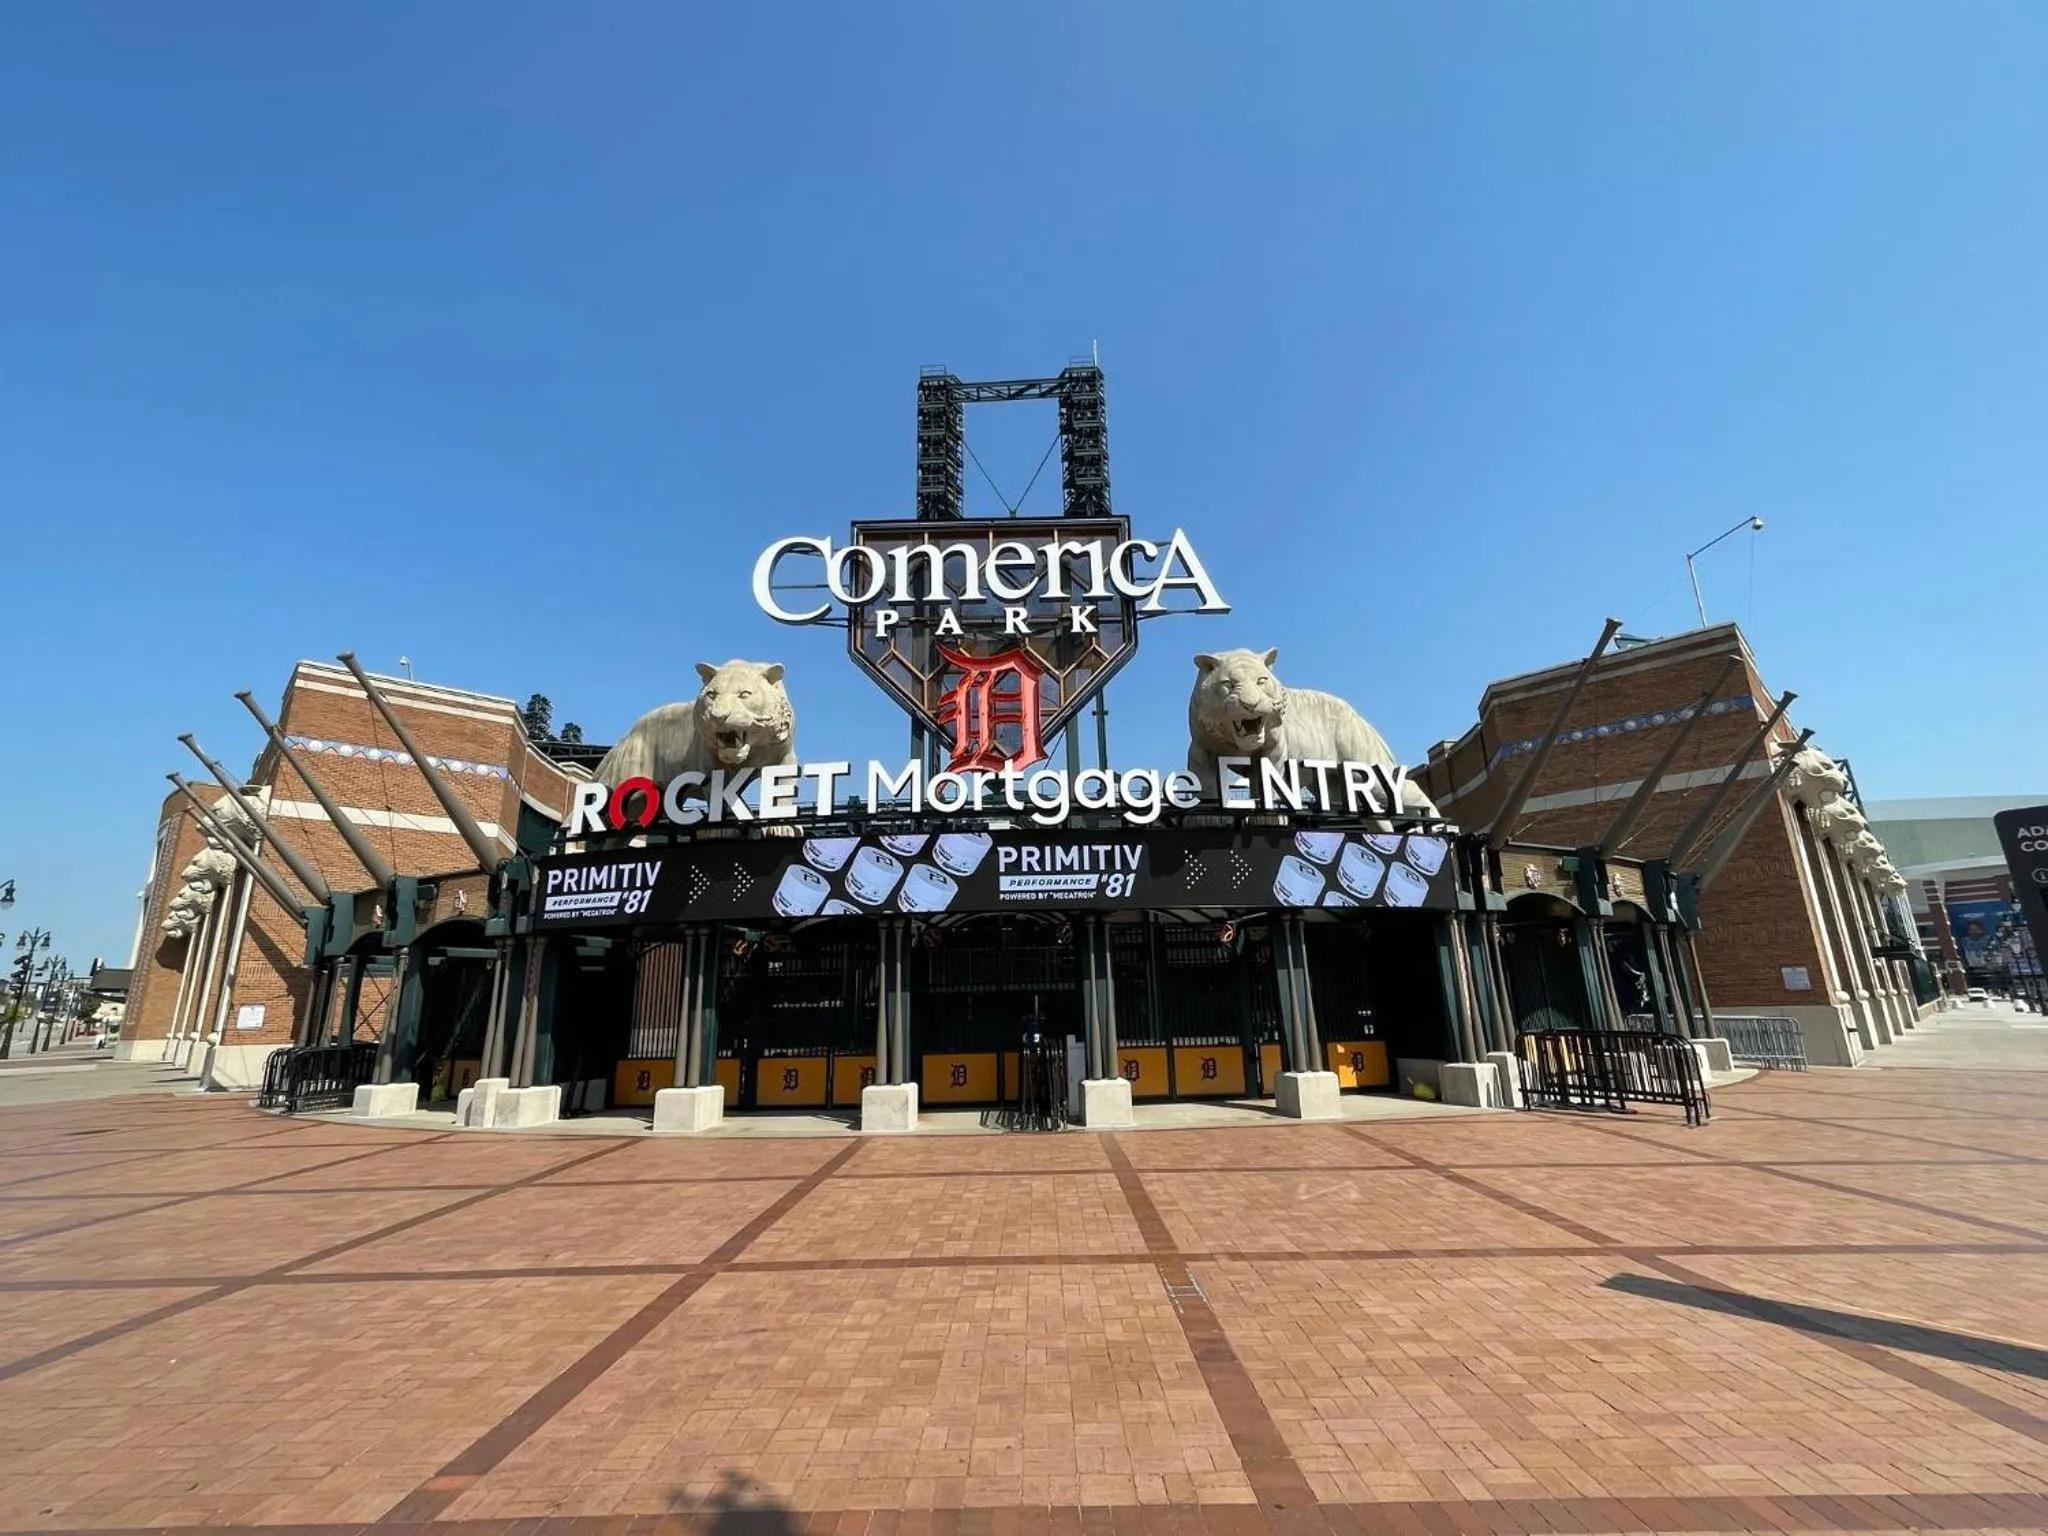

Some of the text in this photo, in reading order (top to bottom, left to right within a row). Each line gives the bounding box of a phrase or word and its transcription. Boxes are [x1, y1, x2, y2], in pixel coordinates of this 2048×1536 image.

[876, 605, 1099, 637] PARK
[571, 756, 1408, 835] ROCKET Mortgage ENTRY
[2017, 825, 2048, 839] AD
[997, 844, 1143, 872] PRIMITIV
[547, 861, 661, 893] PRIMITIV
[1009, 878, 1091, 887] PERFORMANCE
[552, 896, 616, 906] PERFORMANCE
